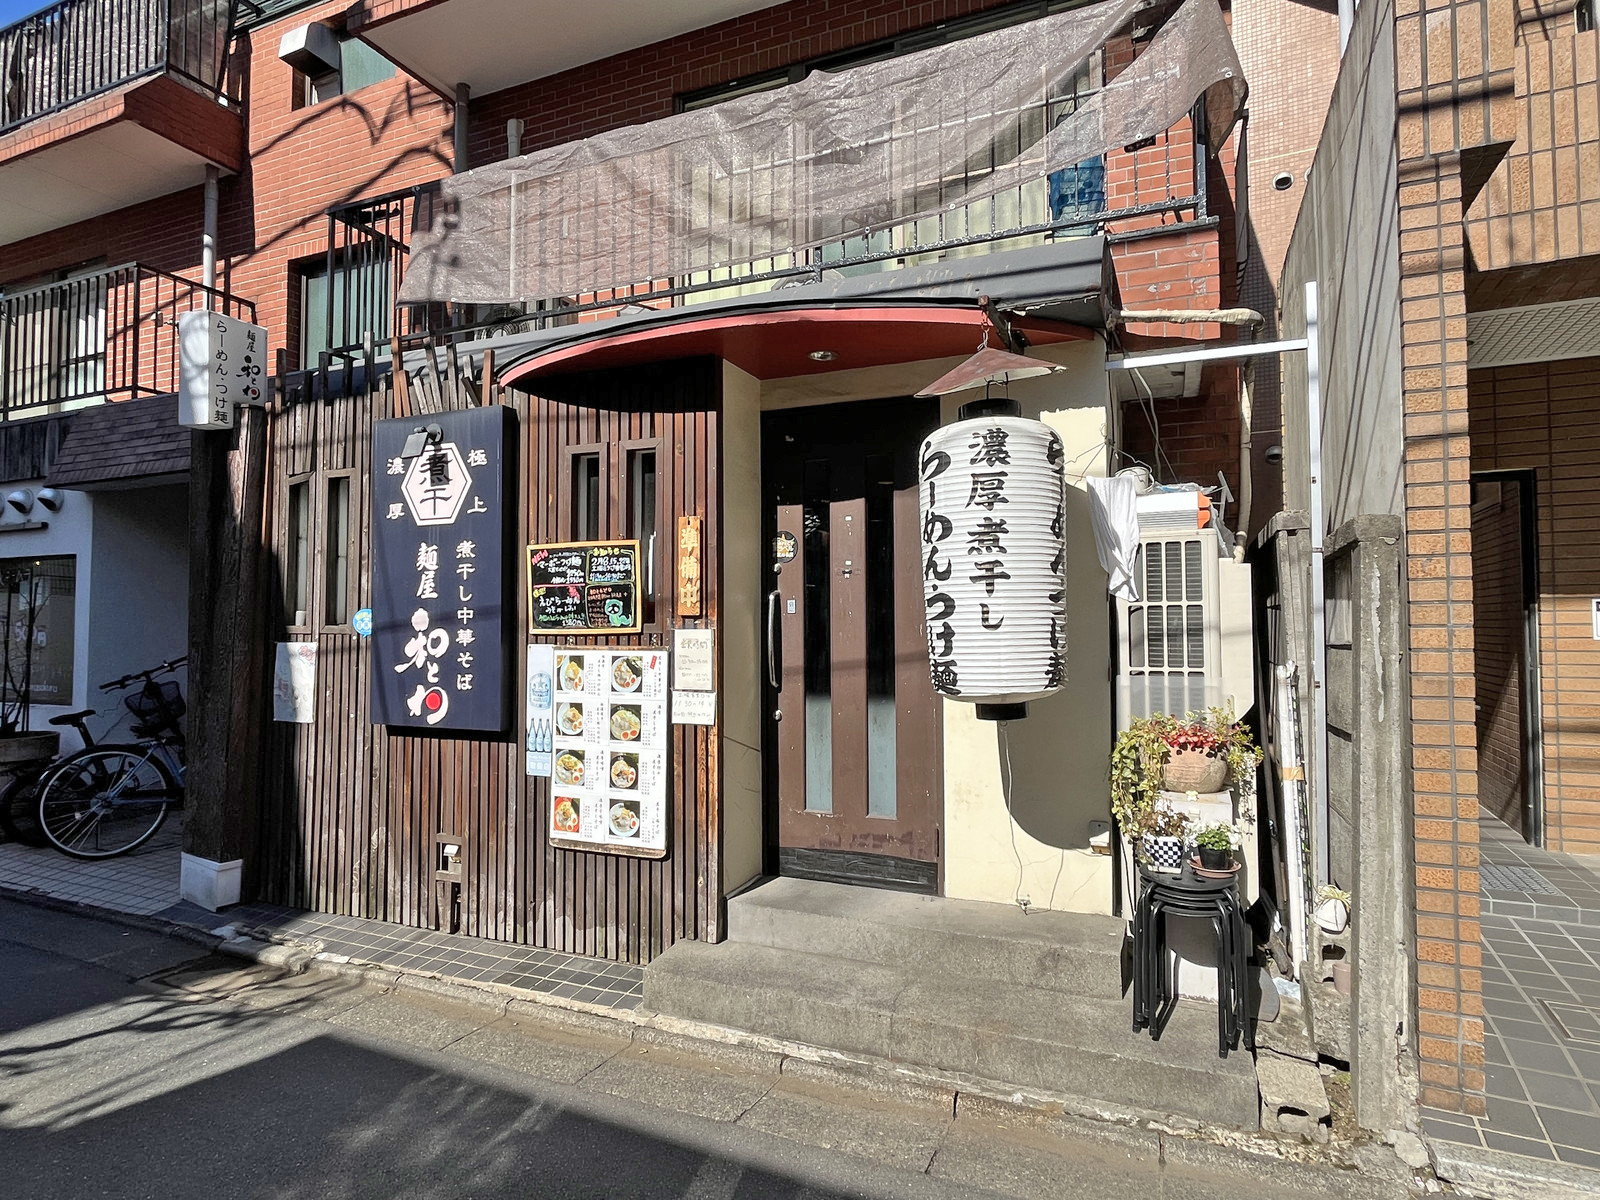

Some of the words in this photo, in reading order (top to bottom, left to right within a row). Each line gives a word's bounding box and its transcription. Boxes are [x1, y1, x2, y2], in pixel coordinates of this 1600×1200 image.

[214, 320, 230, 425] らーめん・つけ麺
[531, 549, 549, 566] NEW
[680, 527, 698, 608] 準備中
[965, 427, 1011, 631] 濃厚煮干し
[456, 540, 477, 691] 煮干し中華そば
